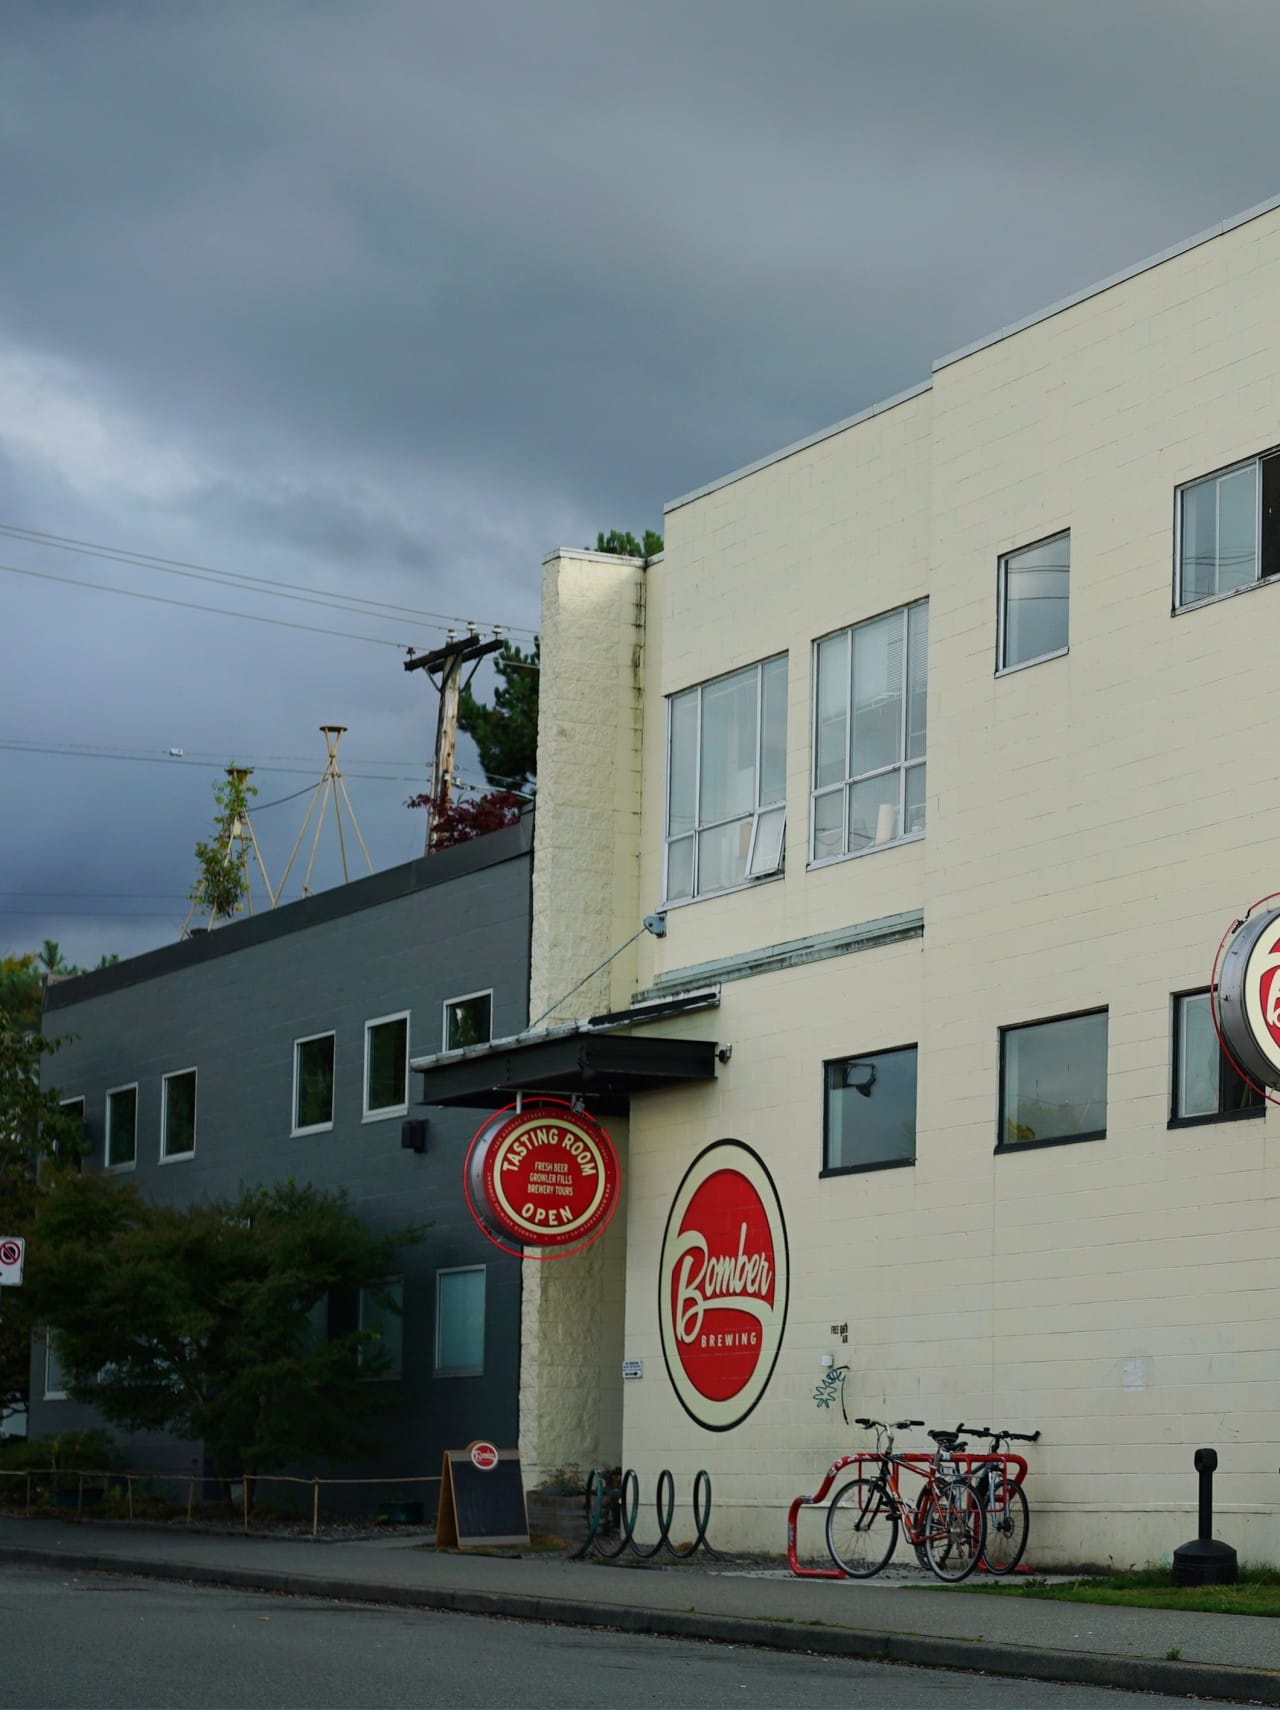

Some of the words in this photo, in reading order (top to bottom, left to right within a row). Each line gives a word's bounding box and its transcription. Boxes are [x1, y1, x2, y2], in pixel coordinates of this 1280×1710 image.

[502, 1128, 559, 1173] TASTING
[561, 1131, 598, 1177] ROOM
[534, 1161, 553, 1172] FRESH
[553, 1163, 569, 1173] BEER
[529, 1172, 556, 1184] GROWLER
[557, 1174, 573, 1185] FILLS
[527, 1184, 554, 1195] BREWERY
[555, 1185, 574, 1197] TOURS
[521, 1203, 574, 1226] OPEN
[675, 1222, 773, 1345] Bomber
[700, 1332, 758, 1348] BREWING
